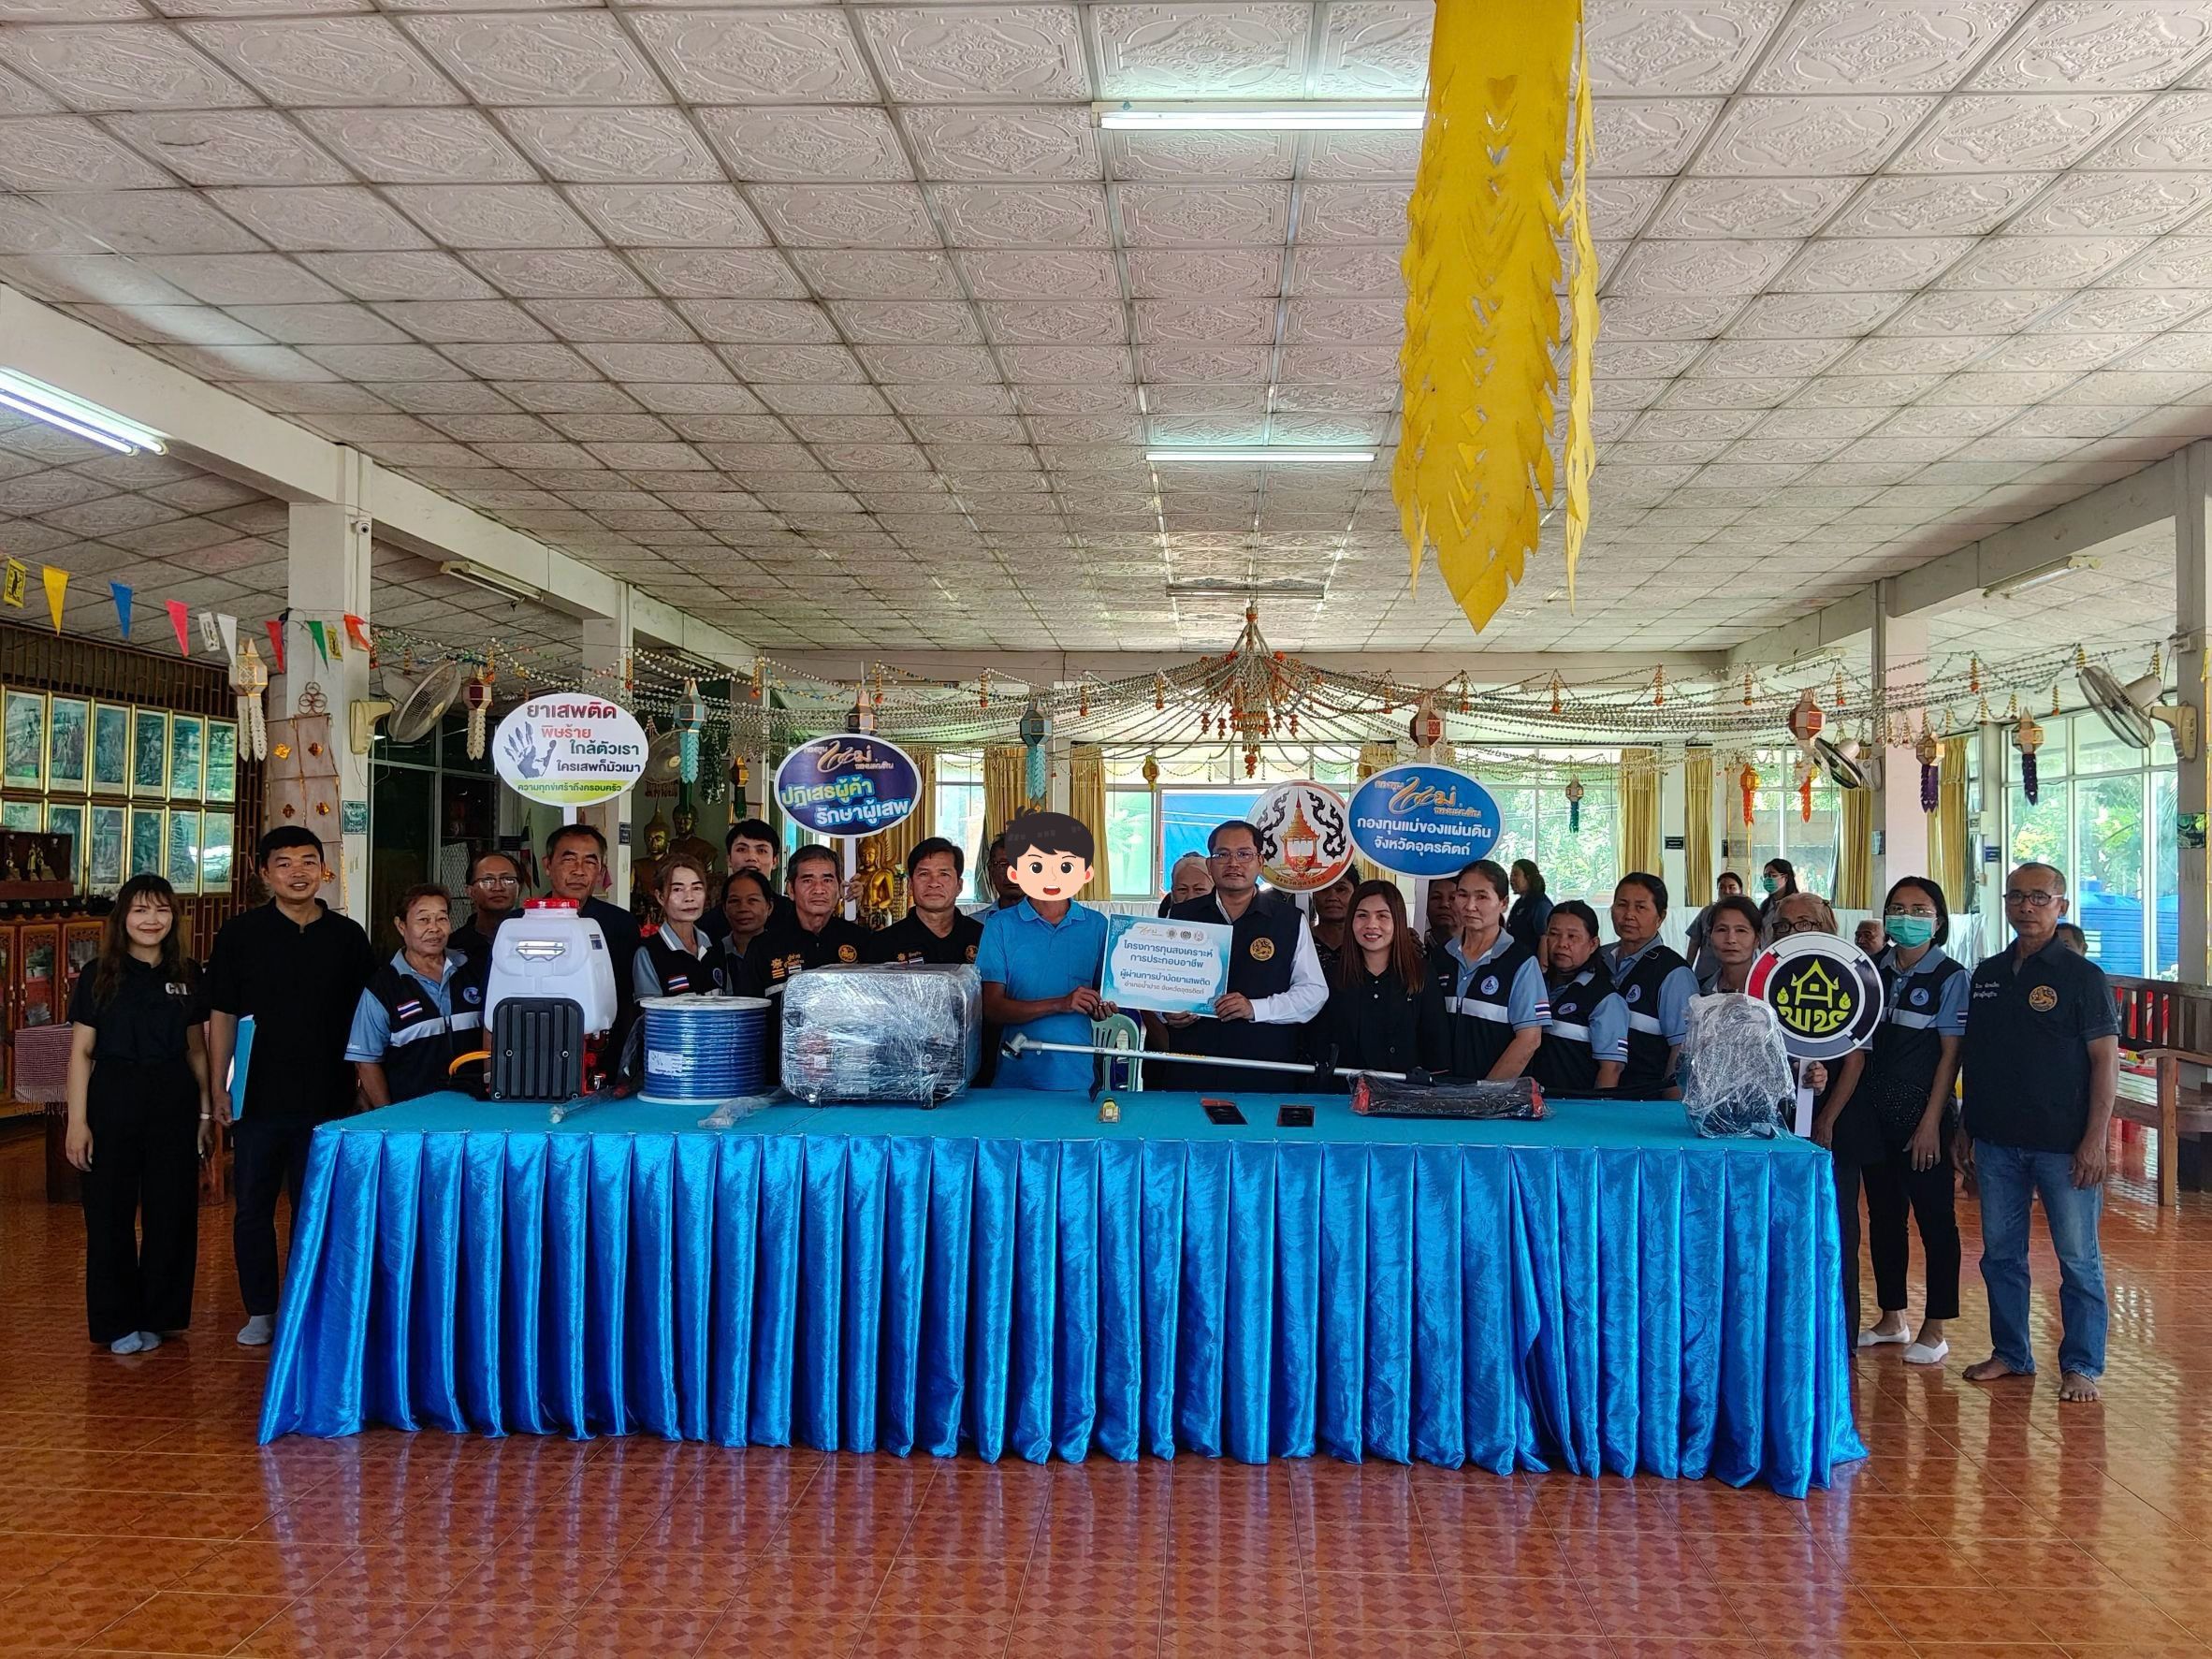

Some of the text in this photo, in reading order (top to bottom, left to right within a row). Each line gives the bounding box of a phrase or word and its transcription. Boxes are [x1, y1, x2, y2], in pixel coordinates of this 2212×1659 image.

[527, 702, 617, 719] ยาเสพติด
[541, 723, 591, 738] พิษร้าย
[569, 739, 639, 755] ใกล้ตัวเรา
[557, 759, 641, 773] ใครเสพก็มัวเมา
[781, 777, 873, 808] ปฏิเสธผู้ค้า
[816, 799, 910, 824] รักษาผู้เสพ
[1357, 817, 1492, 838] กองทุนแม่ของแผ่นดิน
[1375, 837, 1470, 856] จังหวัดอุตรดิตถ์
[1124, 939, 1214, 957] โครงการทุนสงเคราะห์
[1130, 953, 1204, 968] การประกอบอาชีพ
[1120, 968, 1211, 986] ผู้ผ่านการบำบัดยาเสพติด
